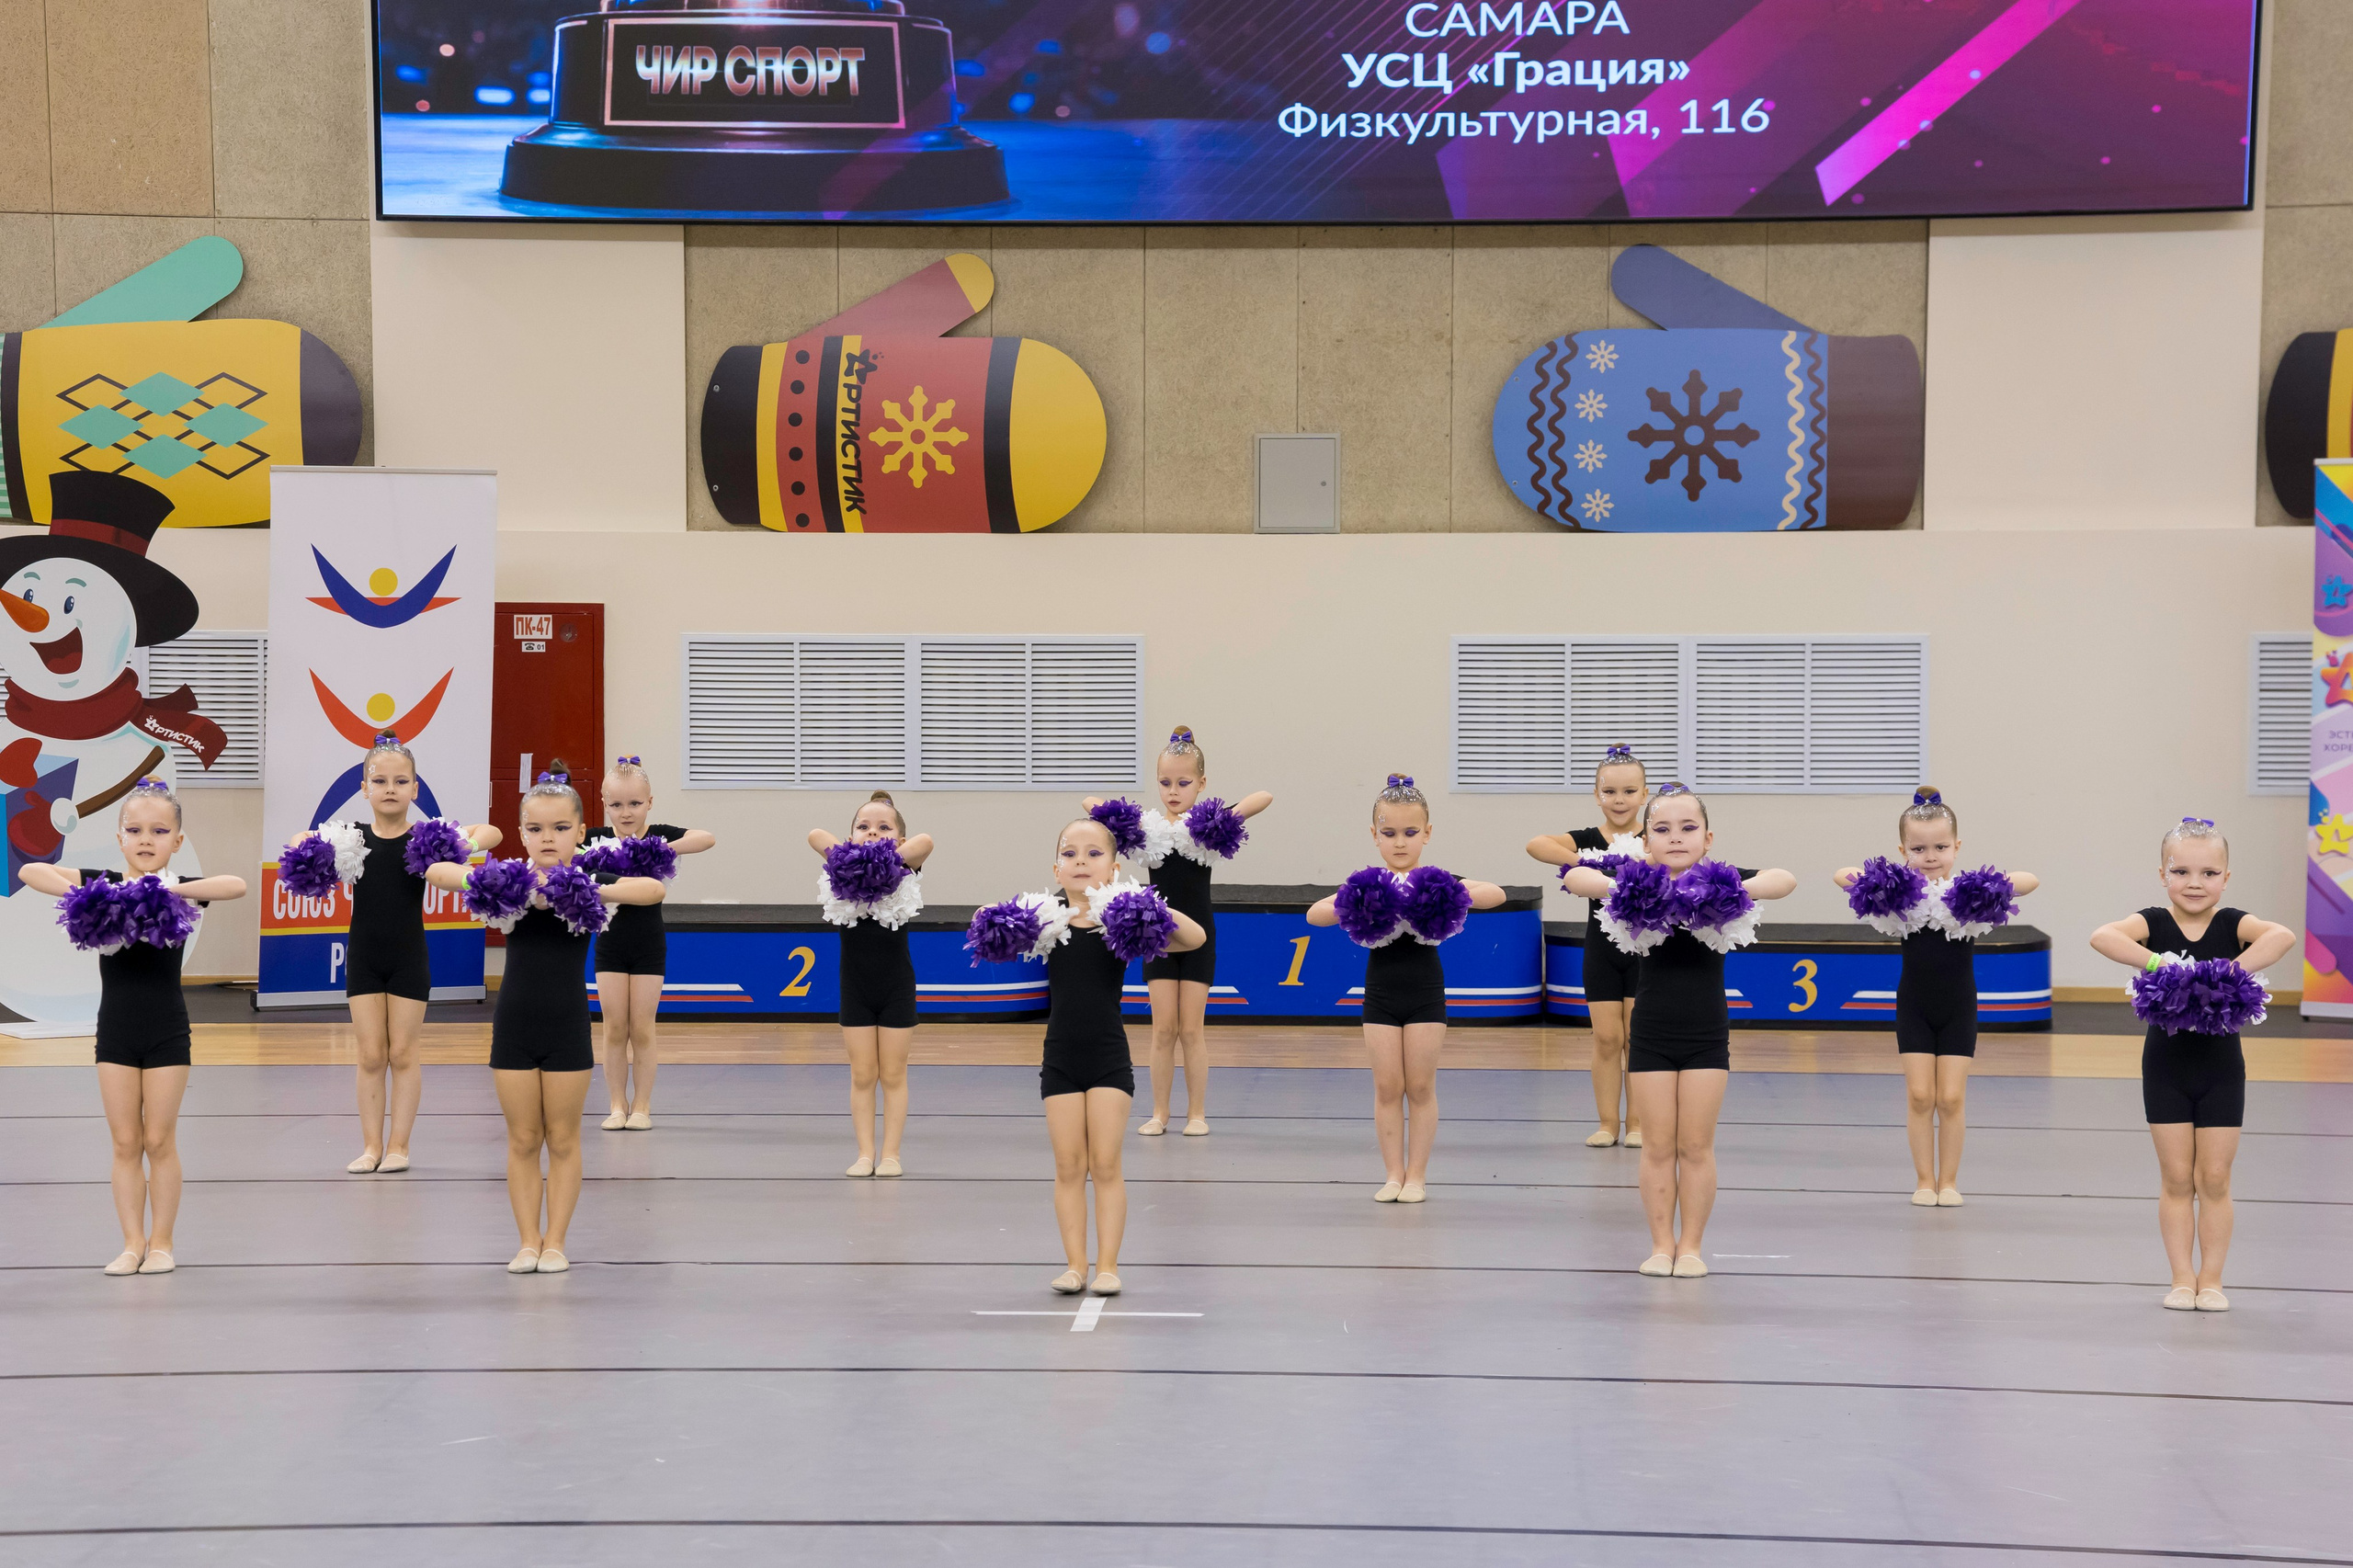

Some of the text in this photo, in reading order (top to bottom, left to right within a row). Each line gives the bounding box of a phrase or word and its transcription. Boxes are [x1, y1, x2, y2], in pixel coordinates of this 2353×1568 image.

[1404, 0, 1631, 38] САМАРА
[635, 44, 866, 97] ЧИР СПОРТ
[1341, 51, 1691, 94] УСЦ «Грация»
[1278, 98, 1770, 145] Физкультурная, 116
[516, 617, 551, 635] ПК-47
[2329, 730, 2353, 739] ЭСТ
[779, 946, 816, 997] 2
[1278, 935, 1311, 986] 1
[1788, 959, 1819, 1013] 3
